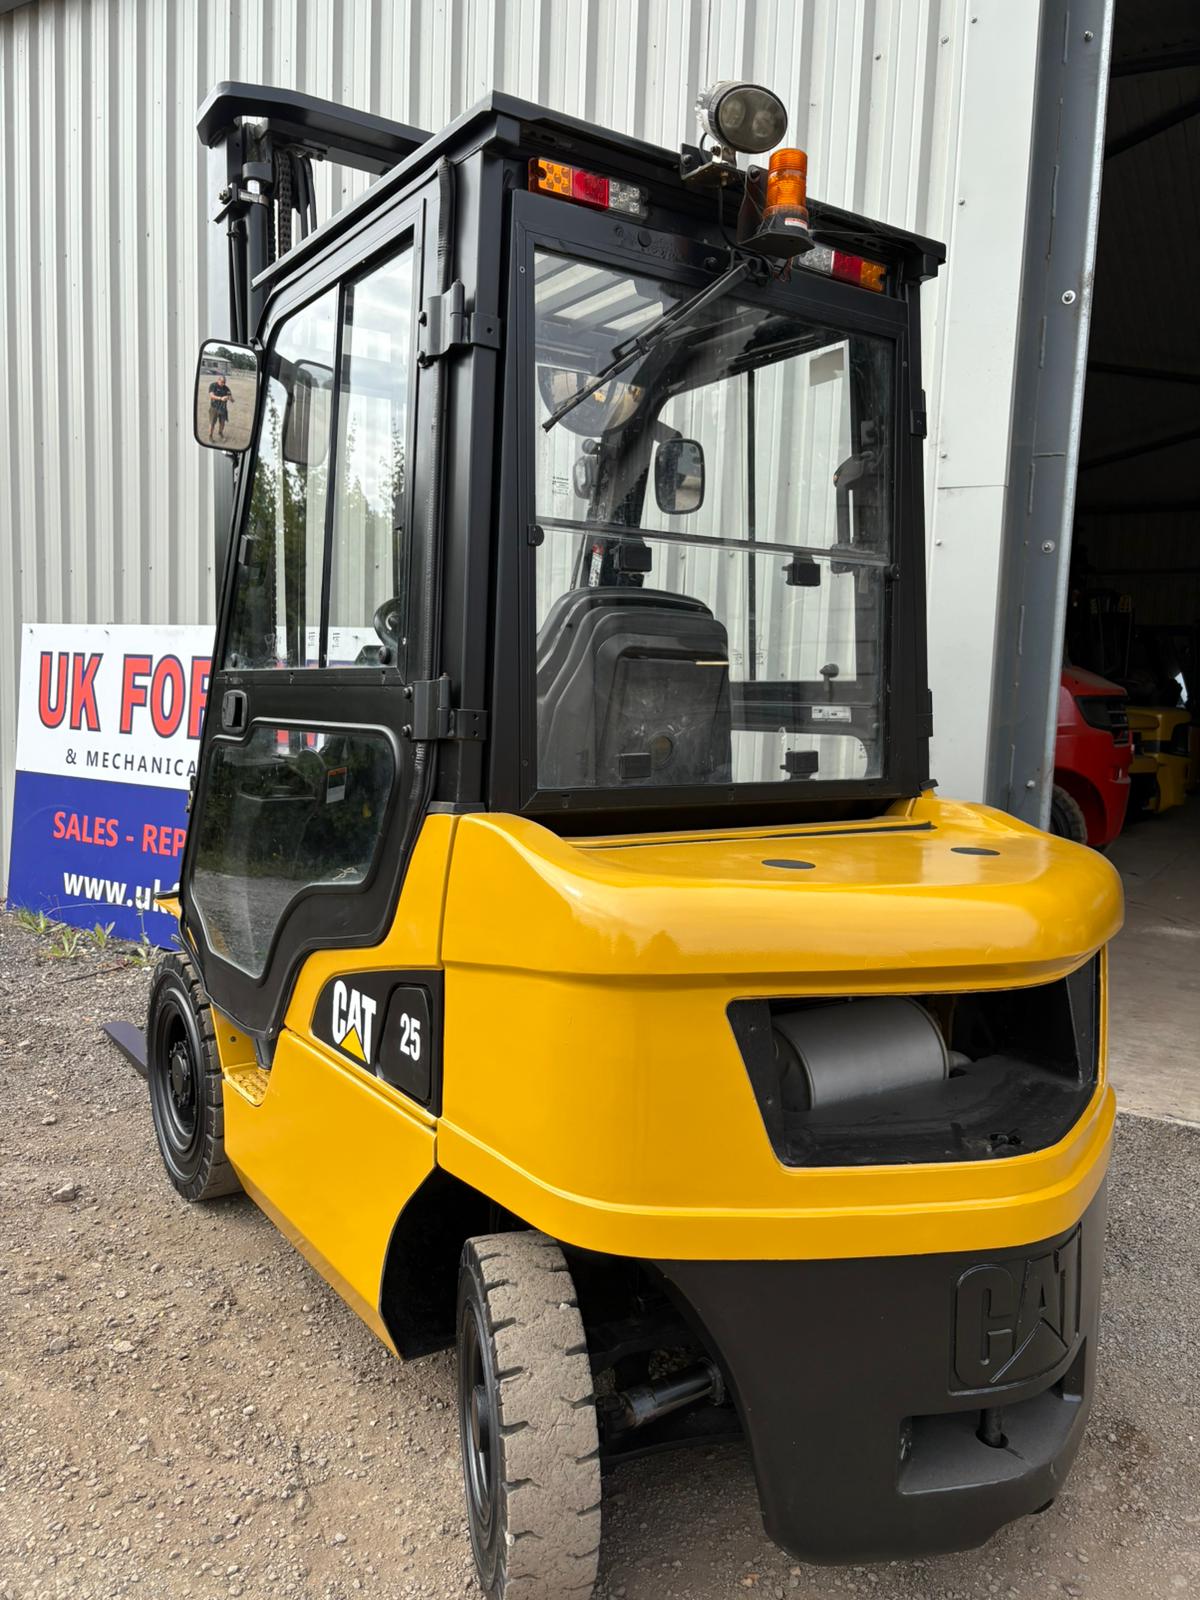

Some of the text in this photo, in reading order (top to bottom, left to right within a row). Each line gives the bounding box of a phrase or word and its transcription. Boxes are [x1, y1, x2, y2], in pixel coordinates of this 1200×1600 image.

[38, 651, 104, 732] UK
[65, 748, 198, 777] & MECHANICA
[53, 811, 119, 847] SALES
[142, 824, 187, 857] REP
[63, 872, 180, 915] www.uk
[332, 980, 377, 1065] CAT
[400, 1012, 421, 1061] 25
